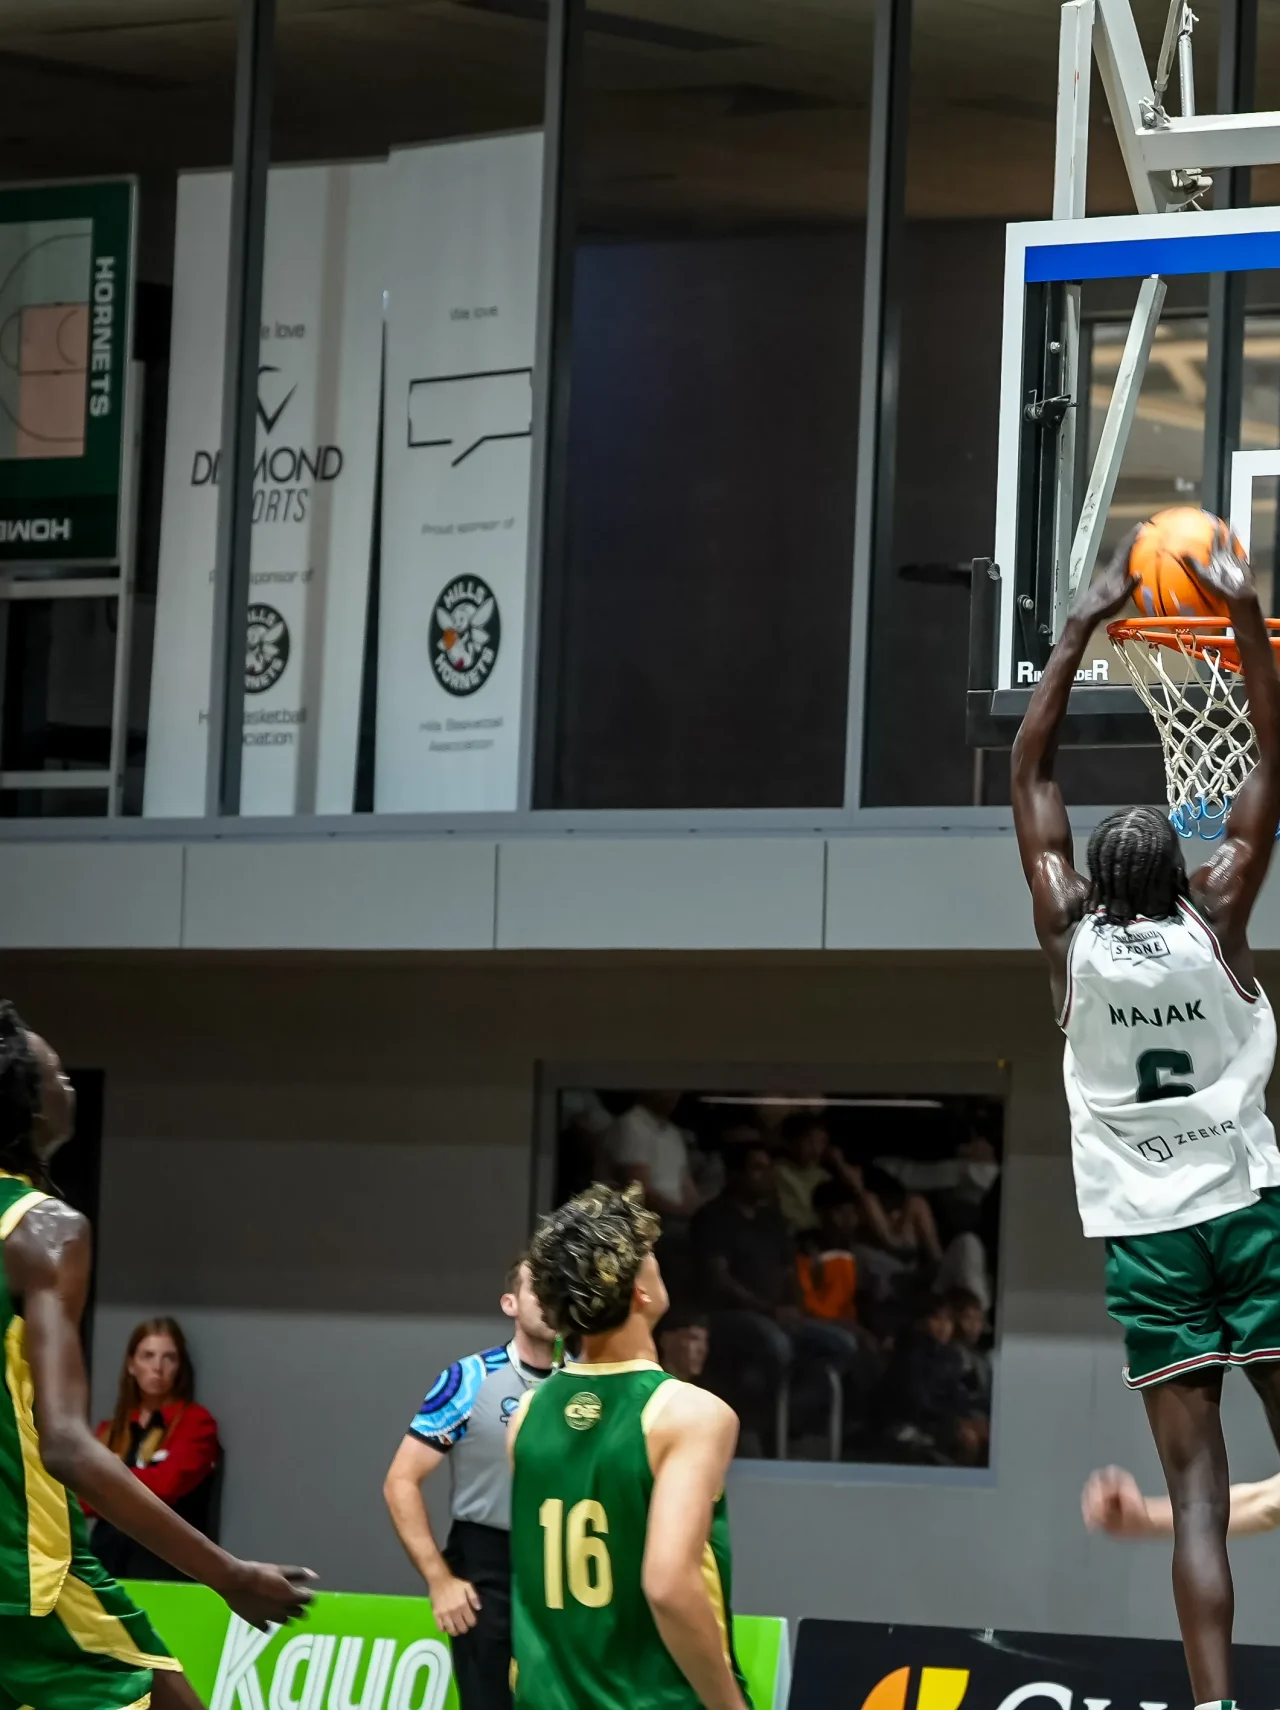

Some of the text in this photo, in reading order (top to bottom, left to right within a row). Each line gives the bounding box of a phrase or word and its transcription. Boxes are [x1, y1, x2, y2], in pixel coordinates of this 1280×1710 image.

[90, 255, 117, 417] HORNETS
[274, 322, 306, 338] love
[191, 445, 343, 487] DIMOND
[252, 488, 309, 524] ORTS
[443, 580, 486, 609] HILLS
[1017, 660, 1109, 683] RINDER
[1116, 941, 1164, 955] STONE
[1108, 998, 1207, 1028] MAJAK
[1173, 1120, 1236, 1146] ZEEKR
[539, 1497, 614, 1610] 16
